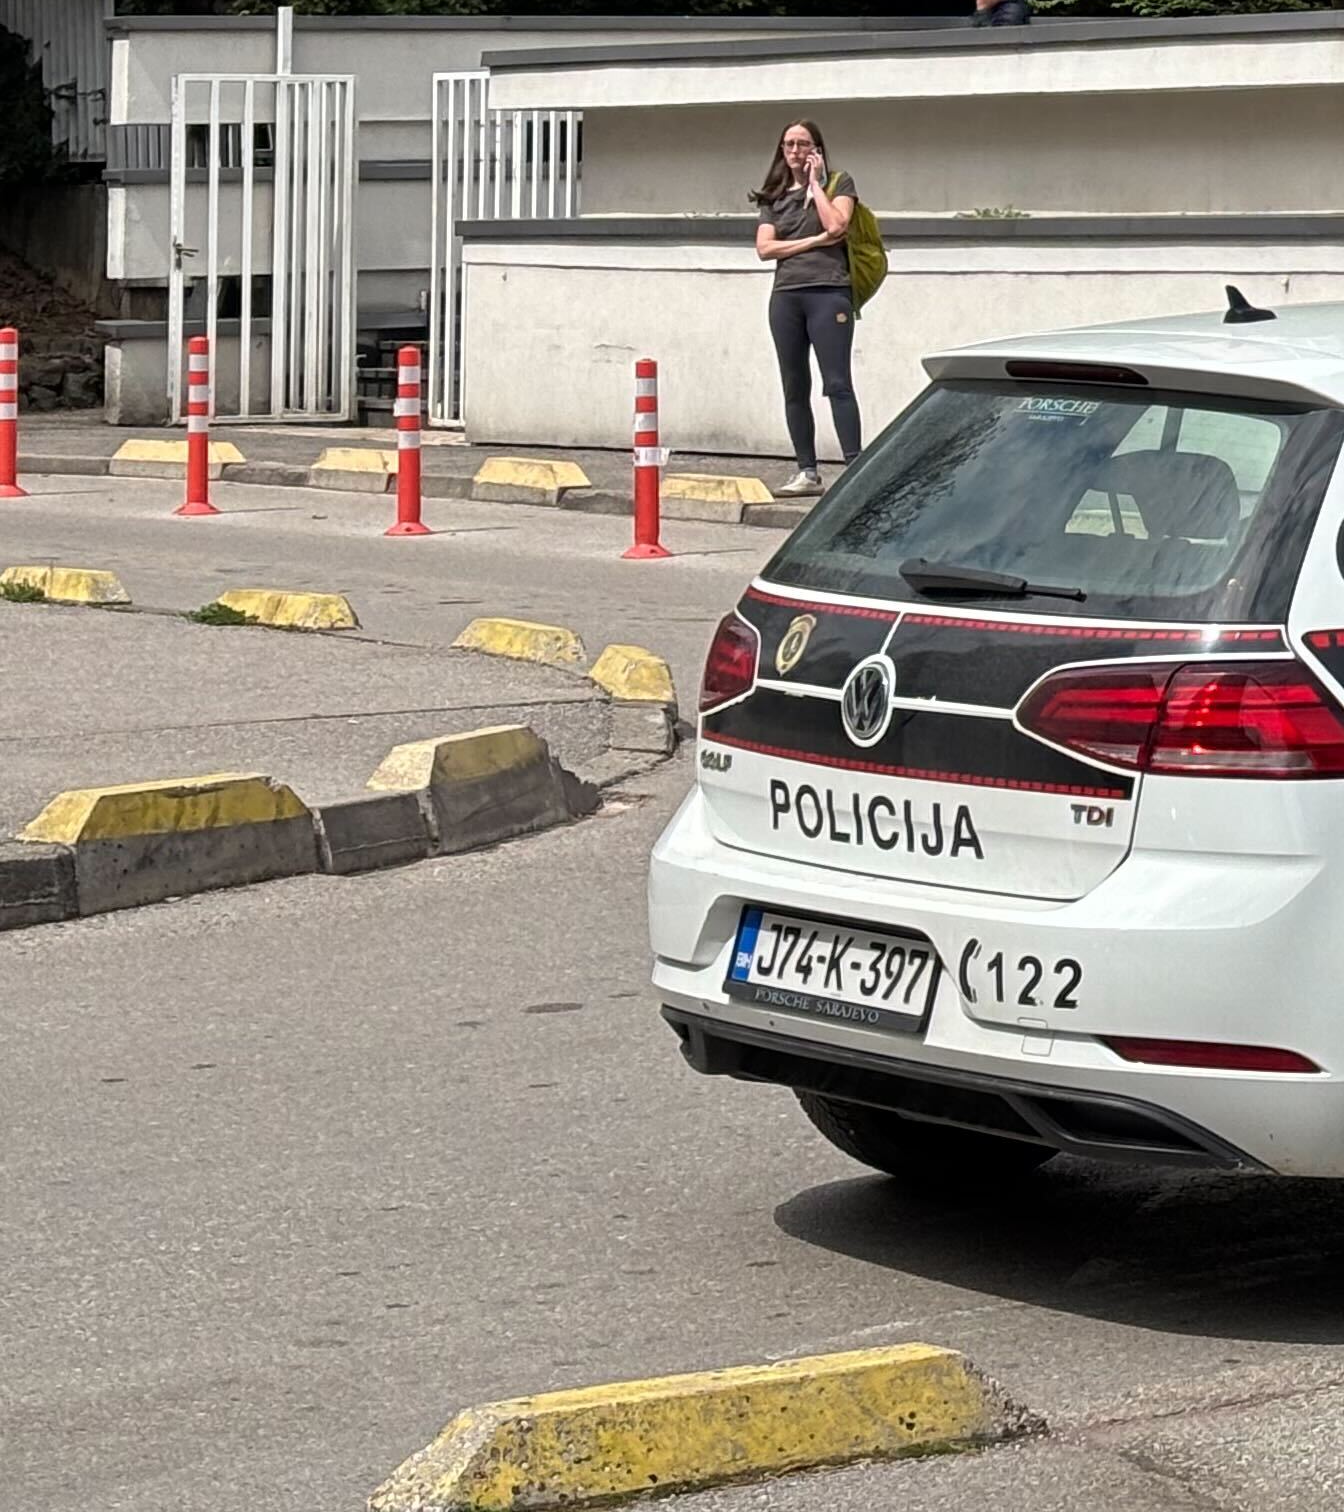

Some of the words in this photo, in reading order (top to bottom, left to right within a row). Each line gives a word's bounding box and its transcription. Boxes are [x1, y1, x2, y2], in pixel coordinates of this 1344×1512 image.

[770, 779, 984, 861] POLICIJA
[1070, 803, 1115, 828] TDI
[757, 922, 930, 1005] J74-K-397
[986, 951, 1083, 1010] 122
[755, 988, 810, 1011] PORSCHE
[815, 1000, 880, 1025] SARAJEVO
